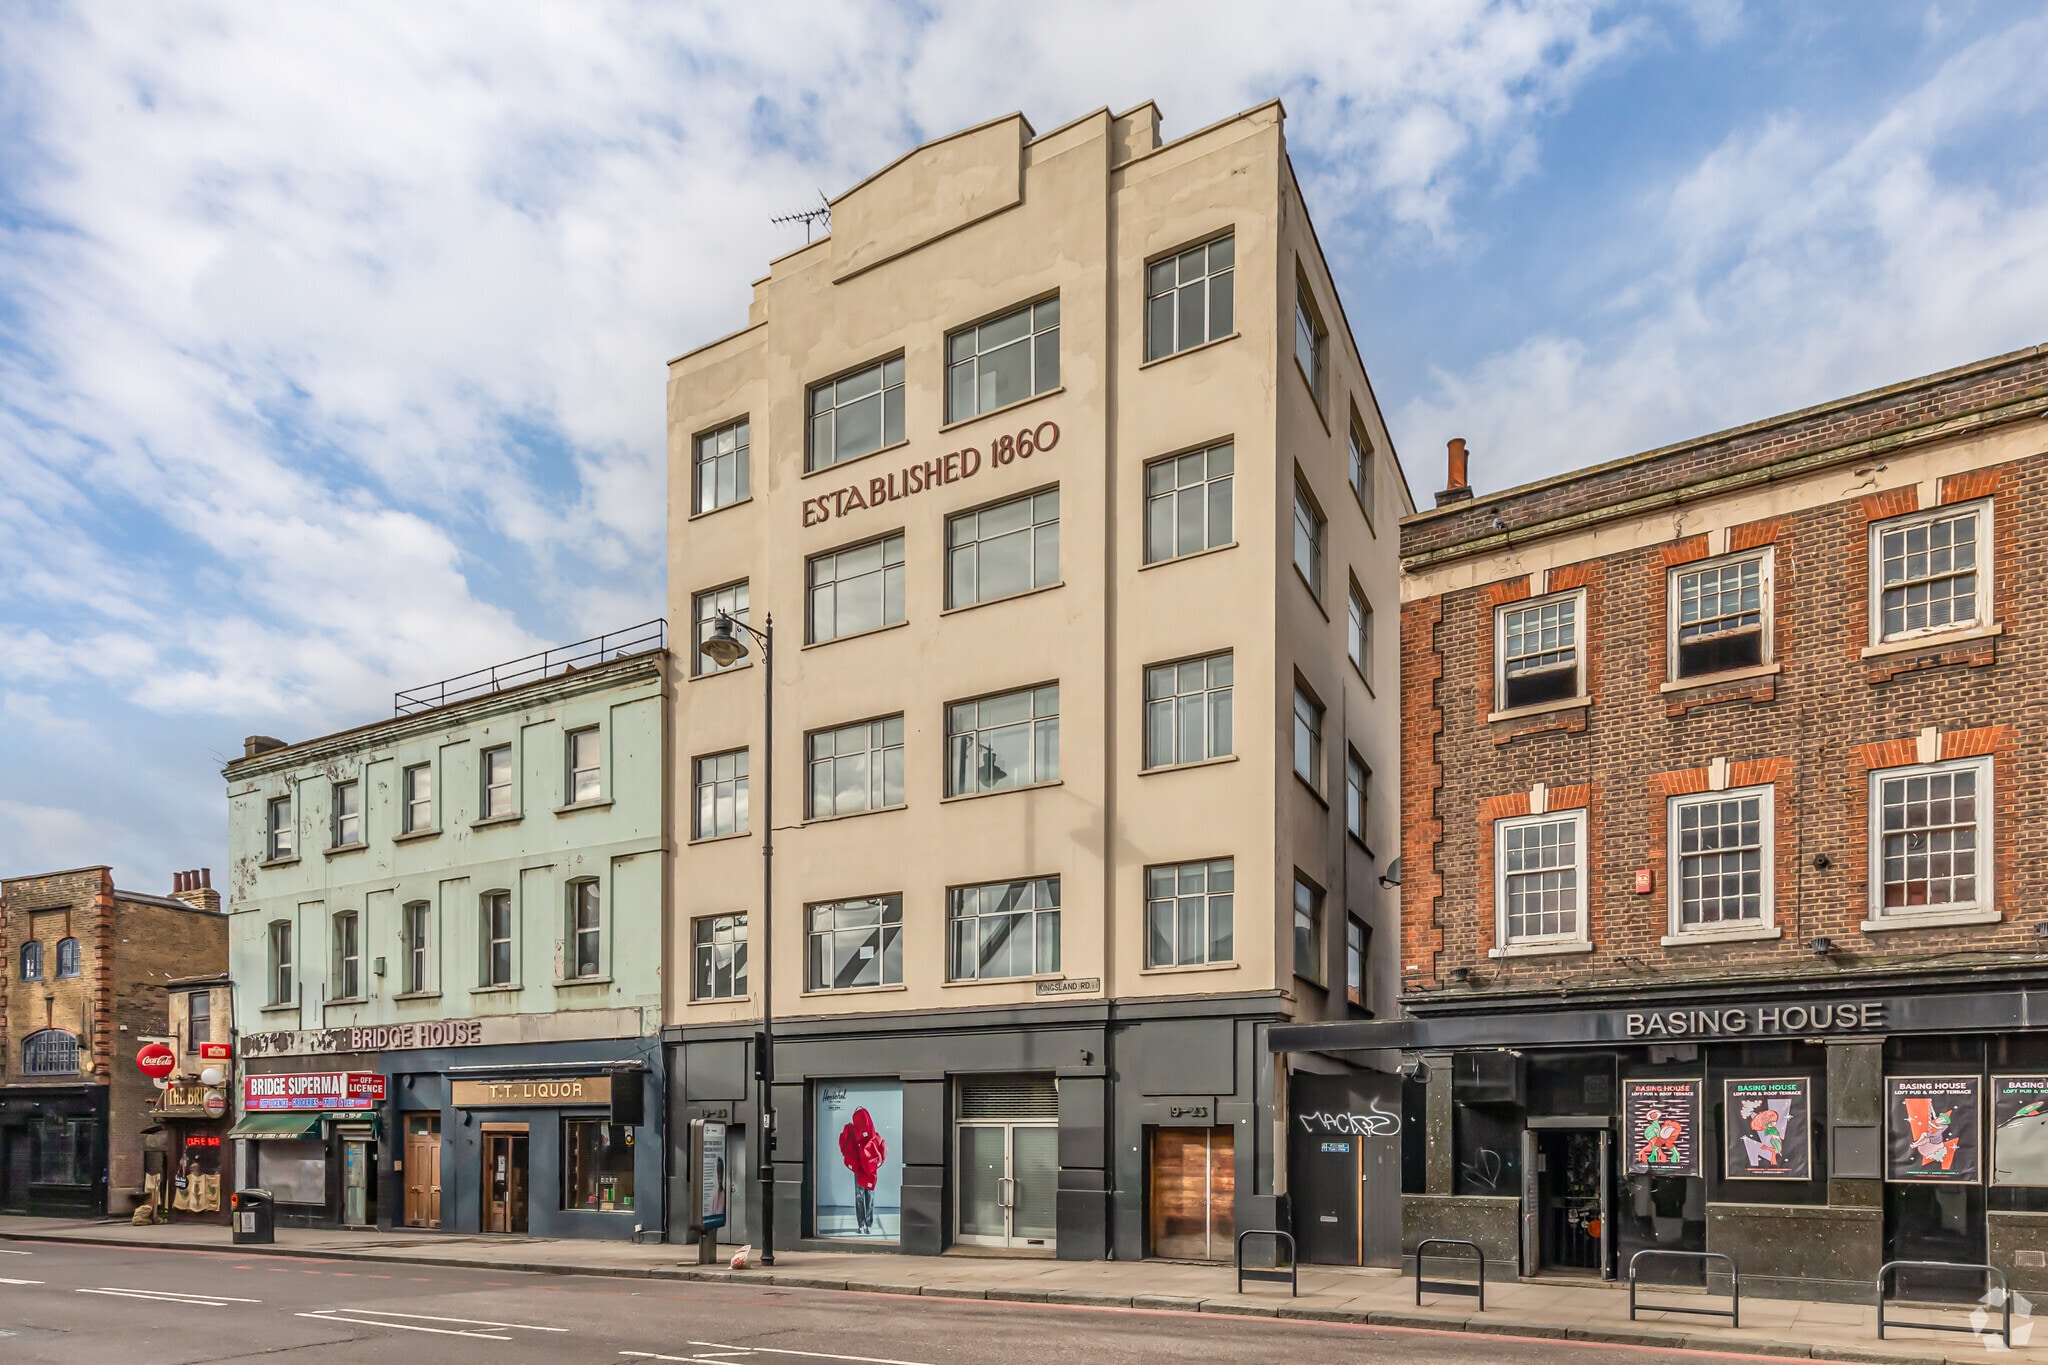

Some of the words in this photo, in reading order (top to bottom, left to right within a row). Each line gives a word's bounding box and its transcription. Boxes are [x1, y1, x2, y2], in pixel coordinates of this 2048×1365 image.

[802, 447, 981, 528] ESTABLISHED
[991, 421, 1060, 468] 1860
[1039, 983, 1077, 992] KINGSLAND
[1626, 1009, 1747, 1036] BASING
[1758, 1003, 1883, 1031] HOUSE
[351, 1025, 414, 1049] BRIDGE
[419, 1022, 481, 1046] HOUSE
[251, 1077, 286, 1095] BRIDGE
[288, 1075, 342, 1095] SUPERMA
[349, 1084, 383, 1093] LICENCE
[360, 1076, 373, 1084] OFF
[169, 1088, 185, 1105] THE
[489, 1085, 517, 1098] T.T.
[523, 1083, 582, 1098] LIQUOR
